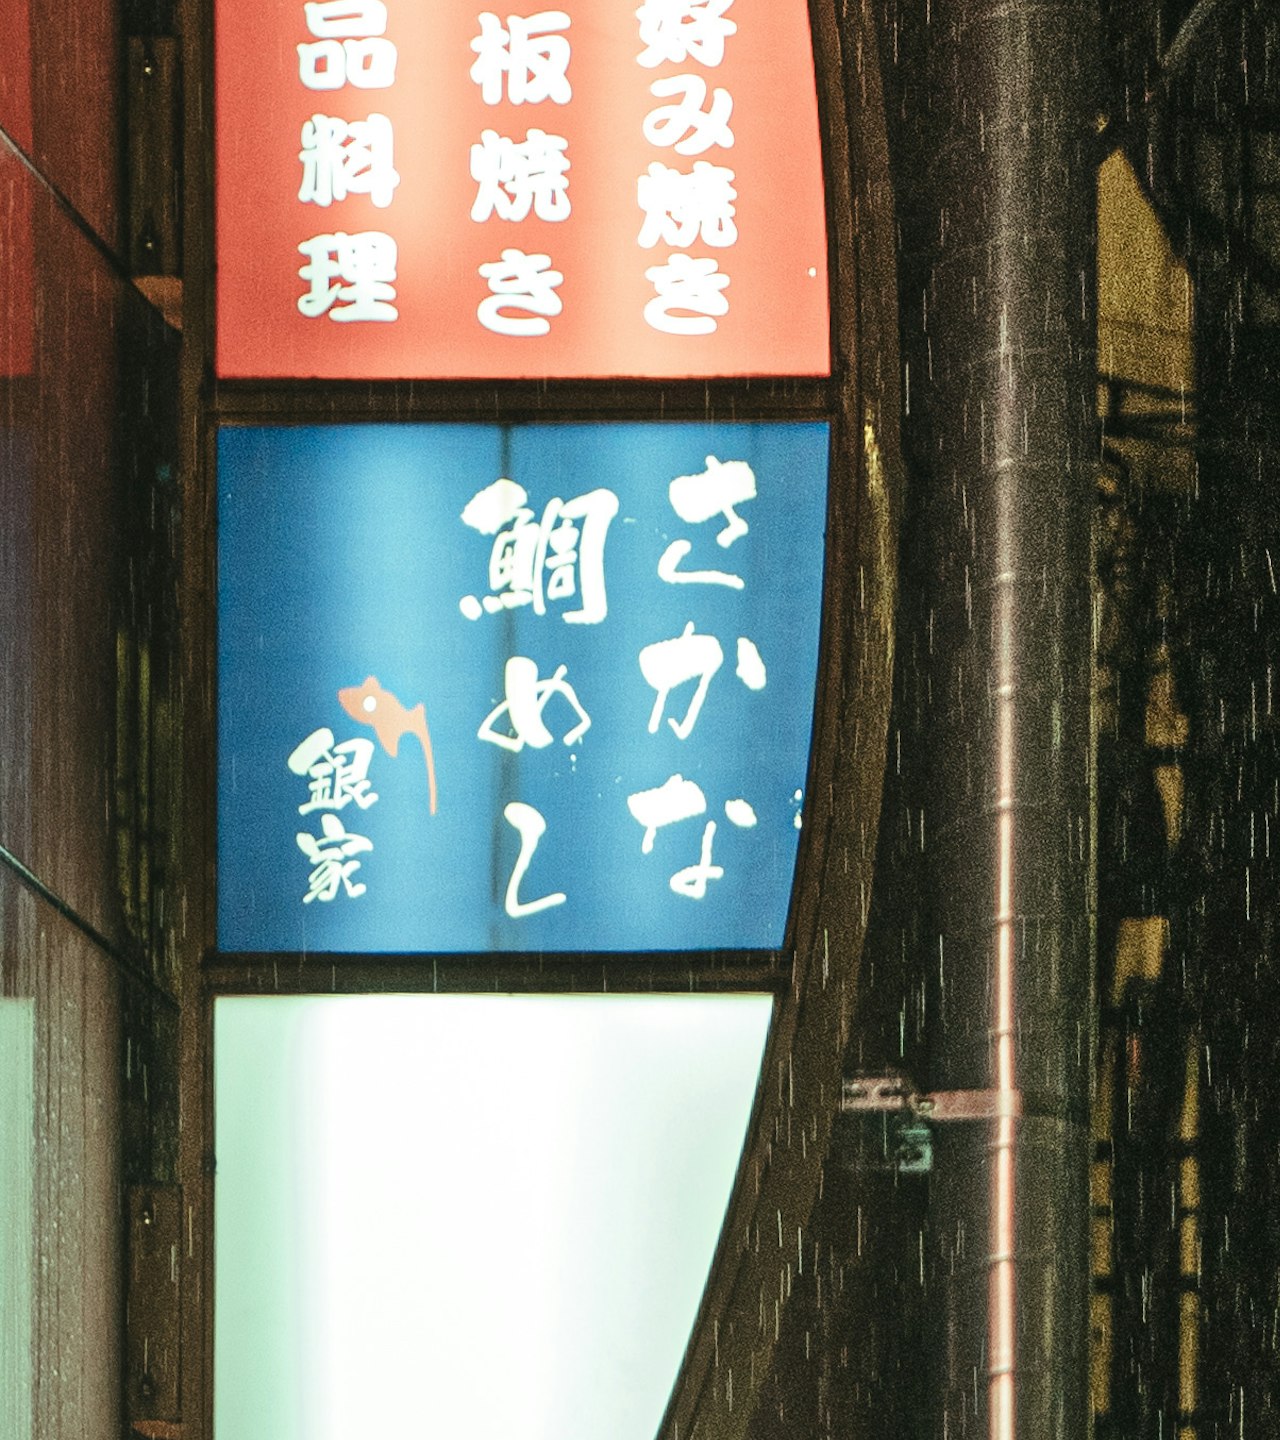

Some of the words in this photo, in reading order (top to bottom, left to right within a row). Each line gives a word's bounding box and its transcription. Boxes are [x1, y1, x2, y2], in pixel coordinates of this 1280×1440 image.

[297, 0, 400, 323] 品料理
[470, 11, 572, 336] 板焼き
[458, 478, 619, 919] 鯛めし
[626, 454, 767, 900] さかな
